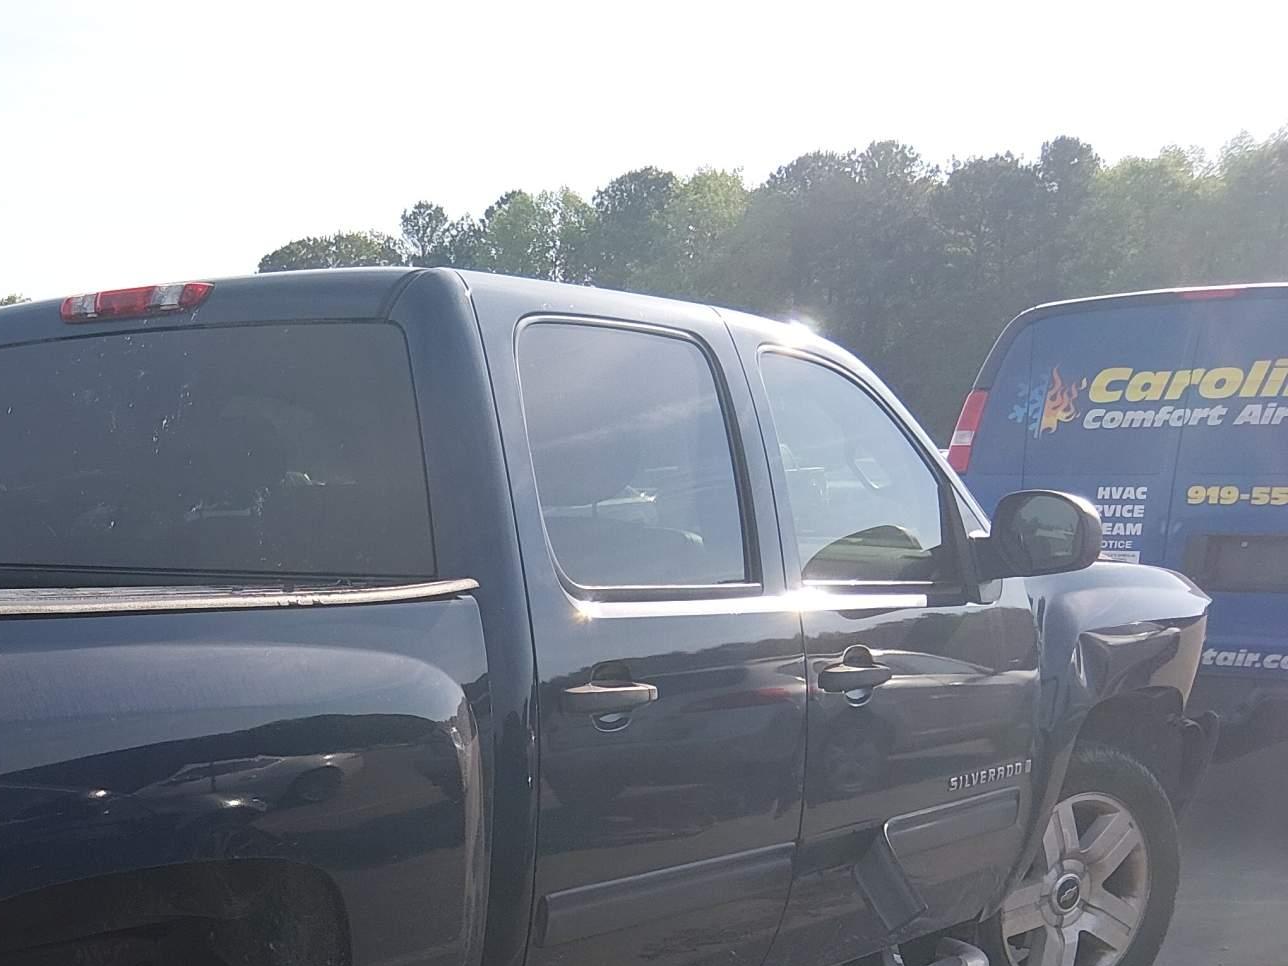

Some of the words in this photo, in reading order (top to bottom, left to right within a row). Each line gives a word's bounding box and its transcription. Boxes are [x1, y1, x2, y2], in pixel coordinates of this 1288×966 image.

[1089, 358, 1288, 404] Caroli
[1083, 404, 1229, 430] Comfort
[1232, 402, 1288, 425] Air
[1097, 486, 1148, 500] HVAC
[1187, 485, 1288, 506] 919-55
[949, 762, 1022, 792] SILVERADO
